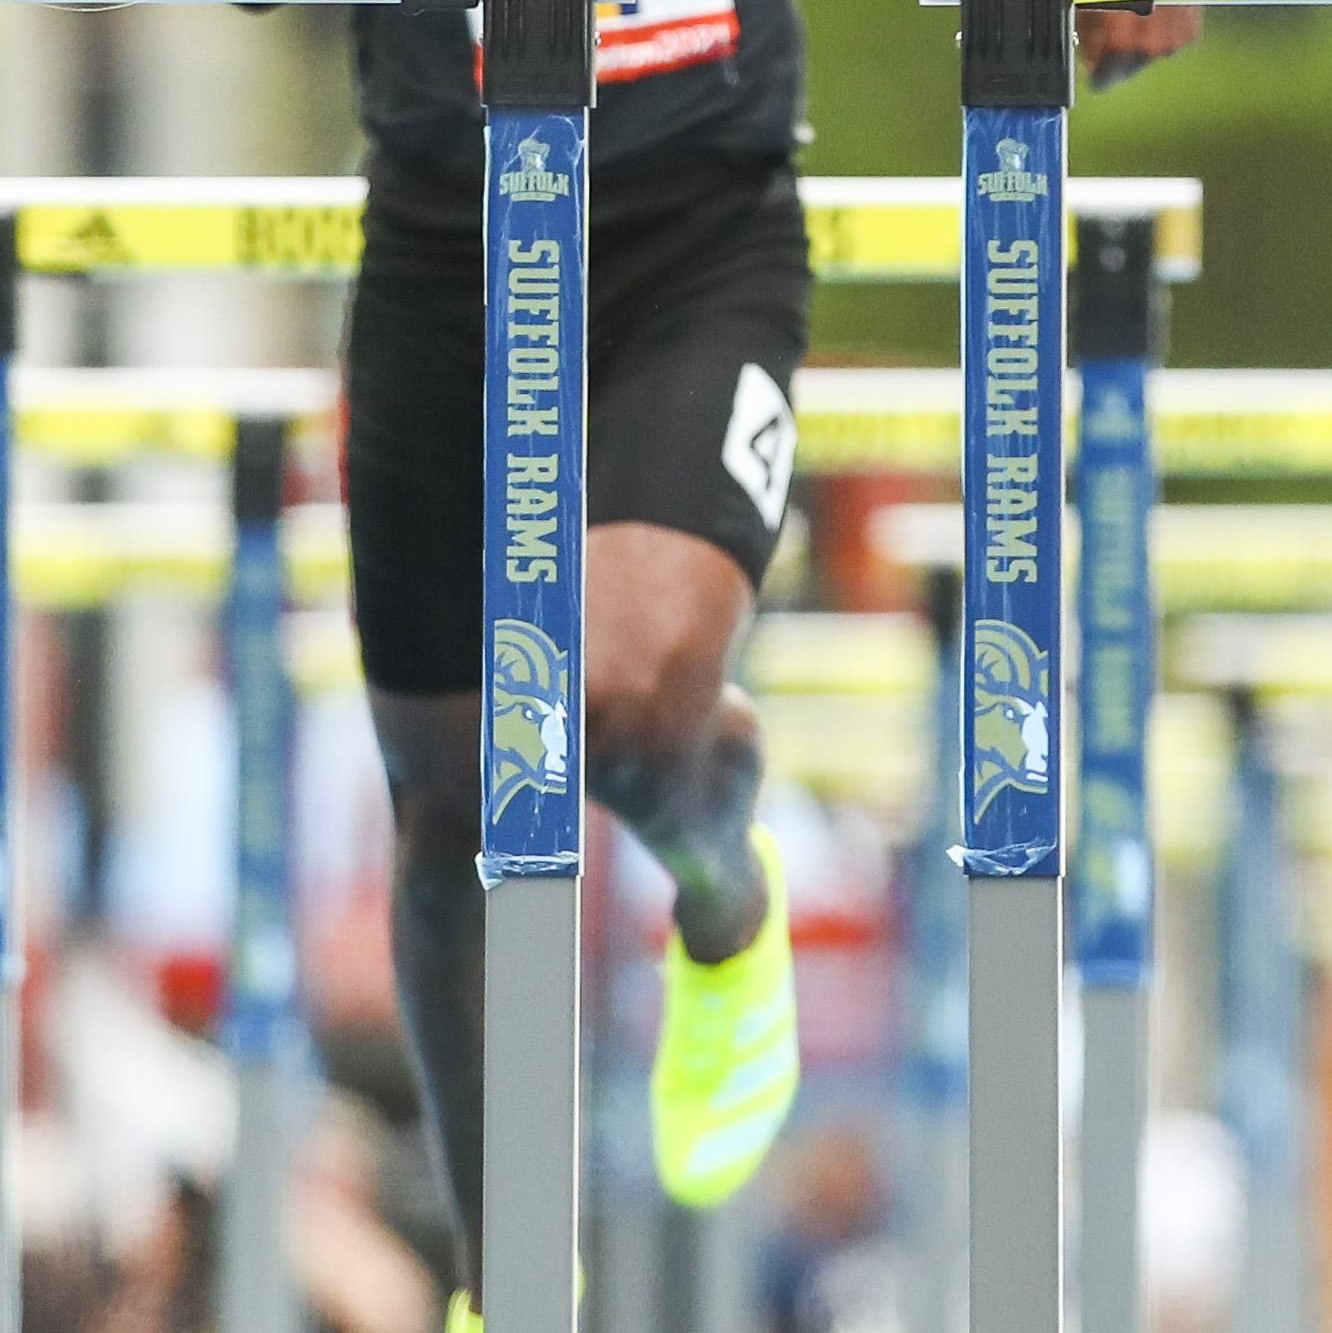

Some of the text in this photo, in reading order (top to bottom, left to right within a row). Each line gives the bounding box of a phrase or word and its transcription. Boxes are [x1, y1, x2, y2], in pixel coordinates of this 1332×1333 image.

[506, 239, 561, 435] SUFFOLK
[986, 239, 1040, 436] SUFFOLK
[506, 455, 561, 583] RAMS
[986, 455, 1040, 584] RAMS
